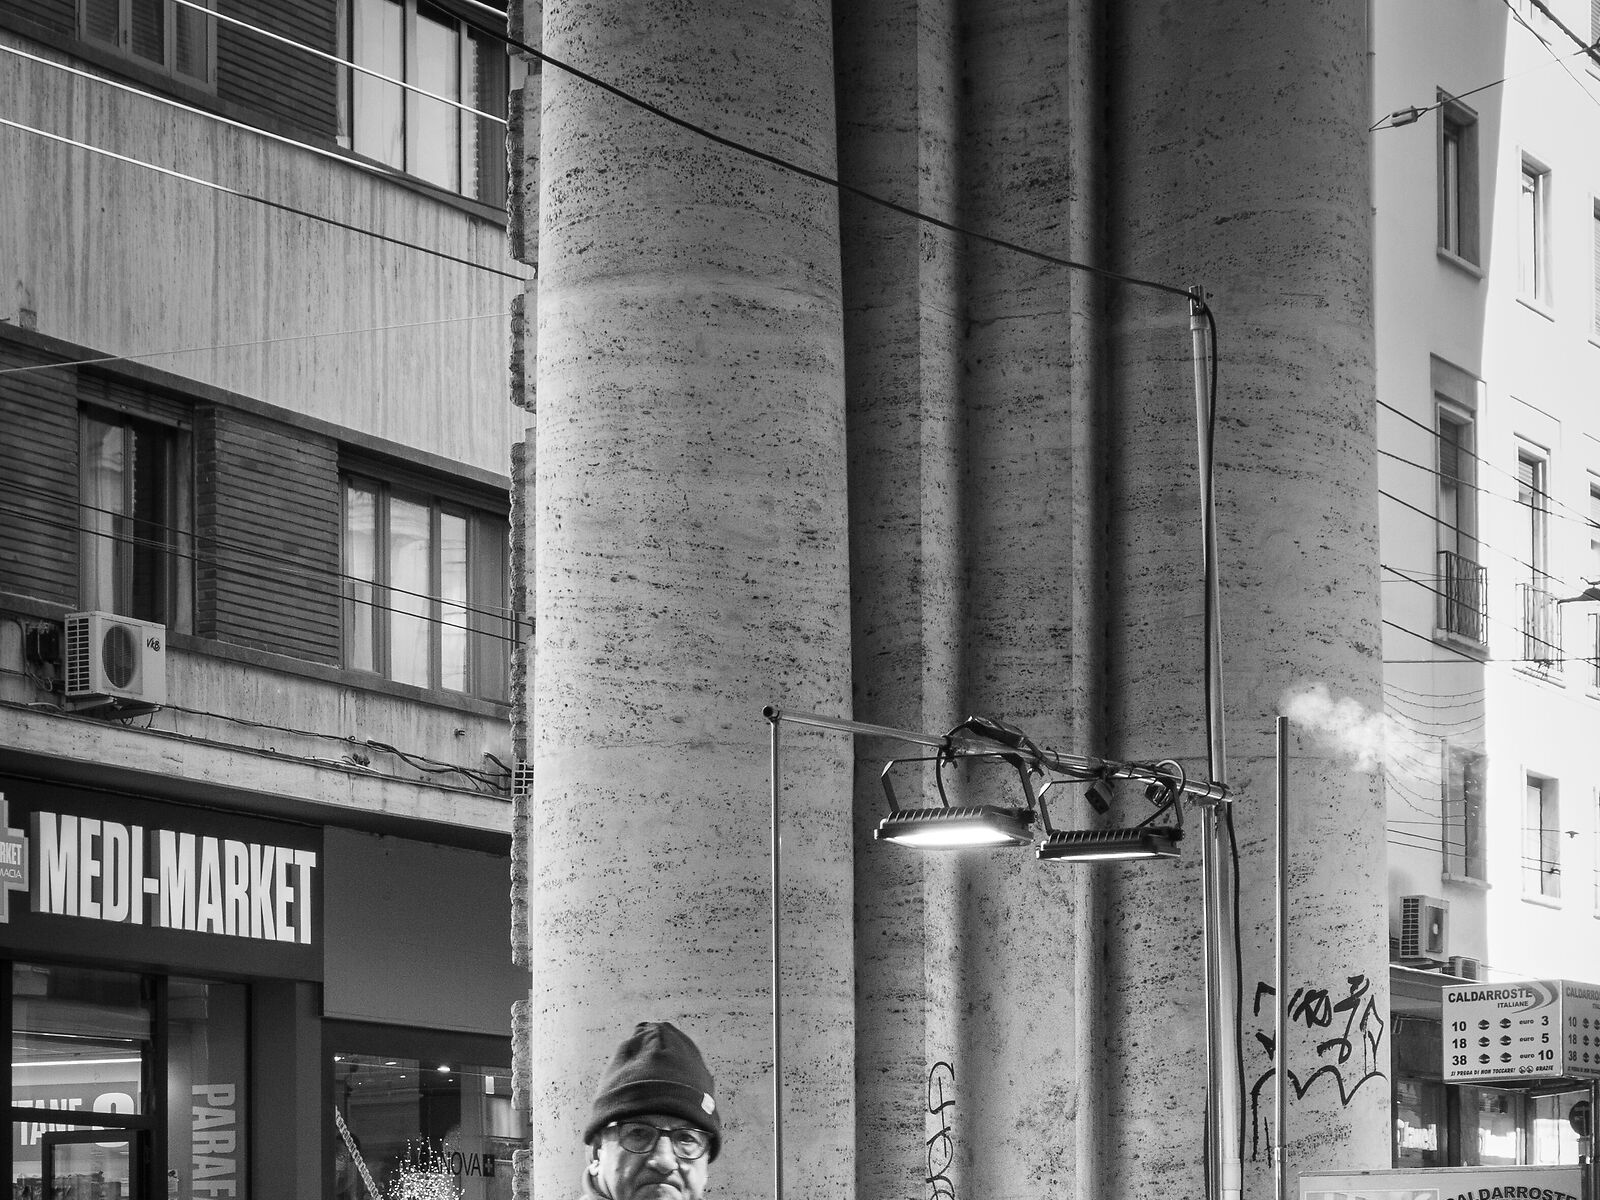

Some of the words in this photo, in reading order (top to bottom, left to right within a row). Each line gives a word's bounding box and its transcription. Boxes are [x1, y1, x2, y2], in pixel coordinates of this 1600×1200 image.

[38, 811, 317, 945] MEDI-MARKET
[1448, 988, 1533, 1003] CALDARROSTE
[1497, 1001, 1529, 1009] ITALIANE
[1452, 1021, 1467, 1032] 10
[1541, 1015, 1549, 1026] 3
[1568, 1016, 1577, 1027] 10
[1452, 1038, 1467, 1049] 18
[1541, 1033, 1549, 1044] 5
[1452, 1055, 1467, 1066] 38
[1538, 1050, 1554, 1061] 10
